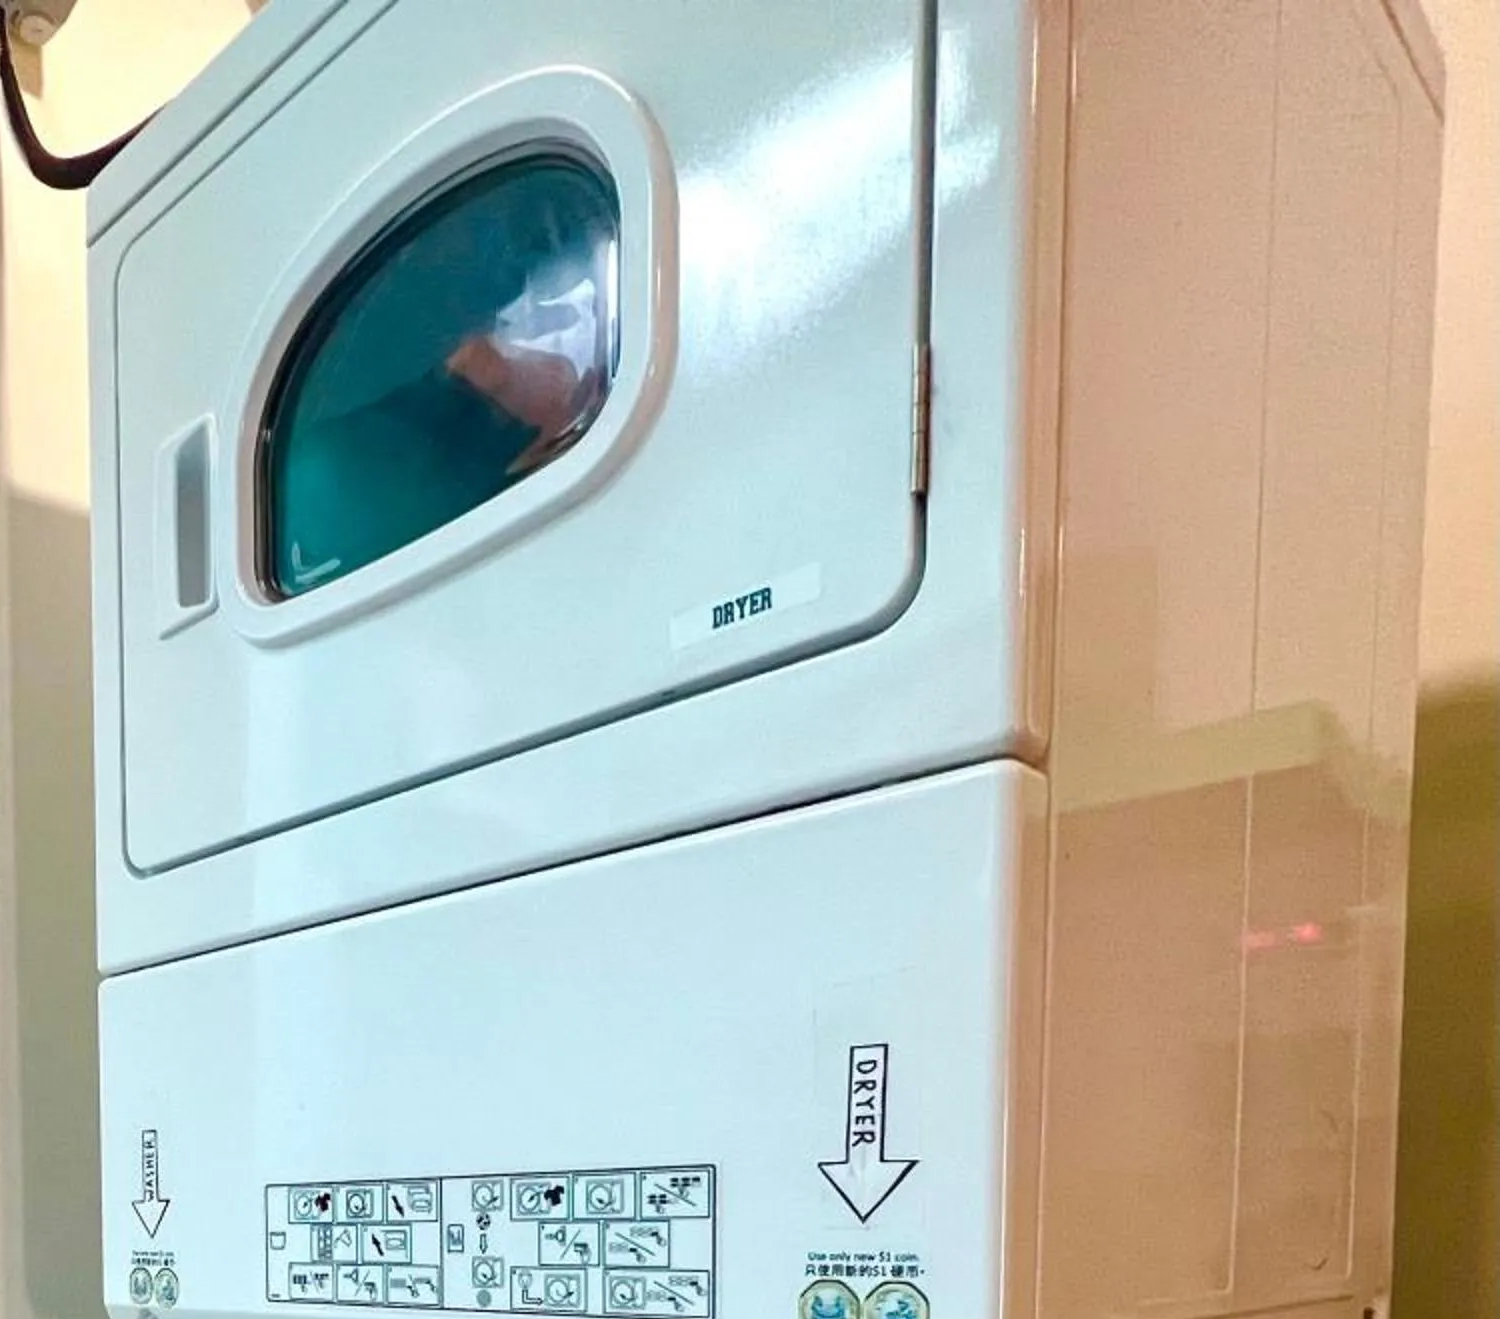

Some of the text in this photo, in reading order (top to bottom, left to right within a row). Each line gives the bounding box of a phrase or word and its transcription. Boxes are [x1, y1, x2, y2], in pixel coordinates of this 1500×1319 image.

[712, 586, 772, 629] DRYER
[852, 1060, 877, 1147] DRYER
[808, 1252, 827, 1261] Use
[829, 1251, 850, 1262] only
[853, 1253, 875, 1261] new
